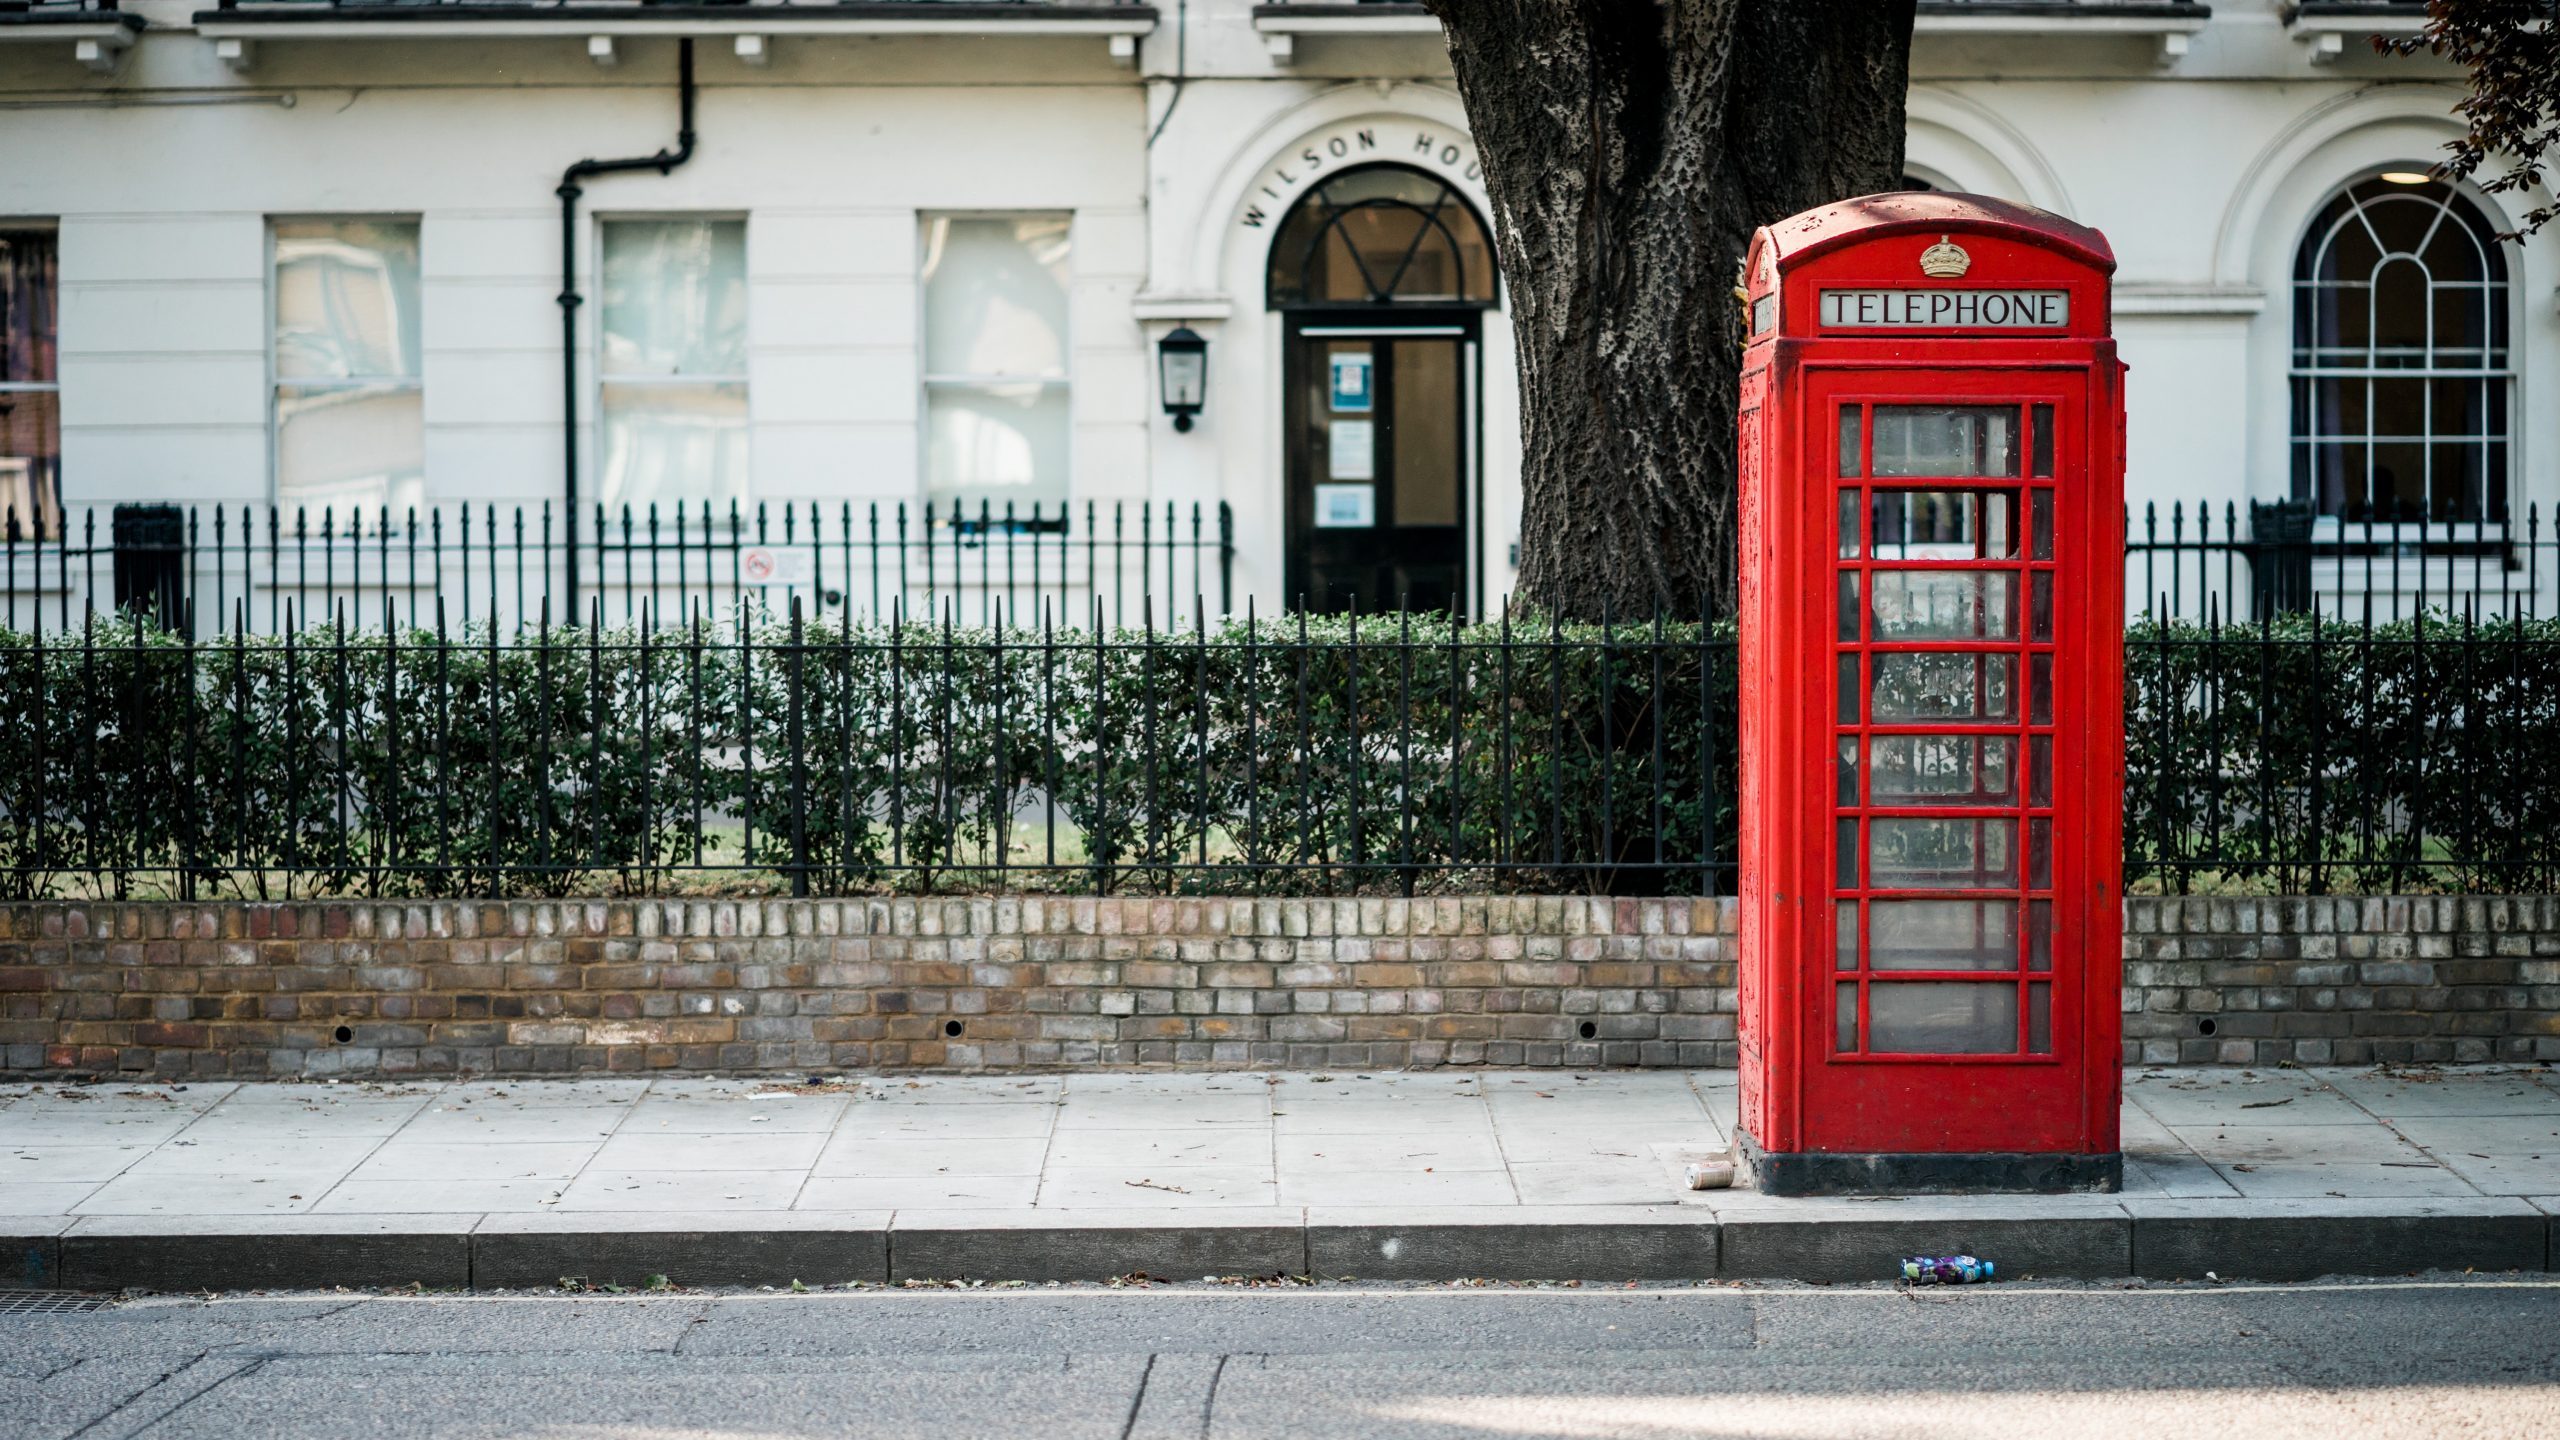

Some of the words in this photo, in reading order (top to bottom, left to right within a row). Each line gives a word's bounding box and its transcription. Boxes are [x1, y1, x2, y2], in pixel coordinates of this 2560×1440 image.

[1242, 129, 1376, 228] WILSON
[1413, 132, 1488, 197] HOU
[1828, 294, 2059, 324] TELEPHONE
